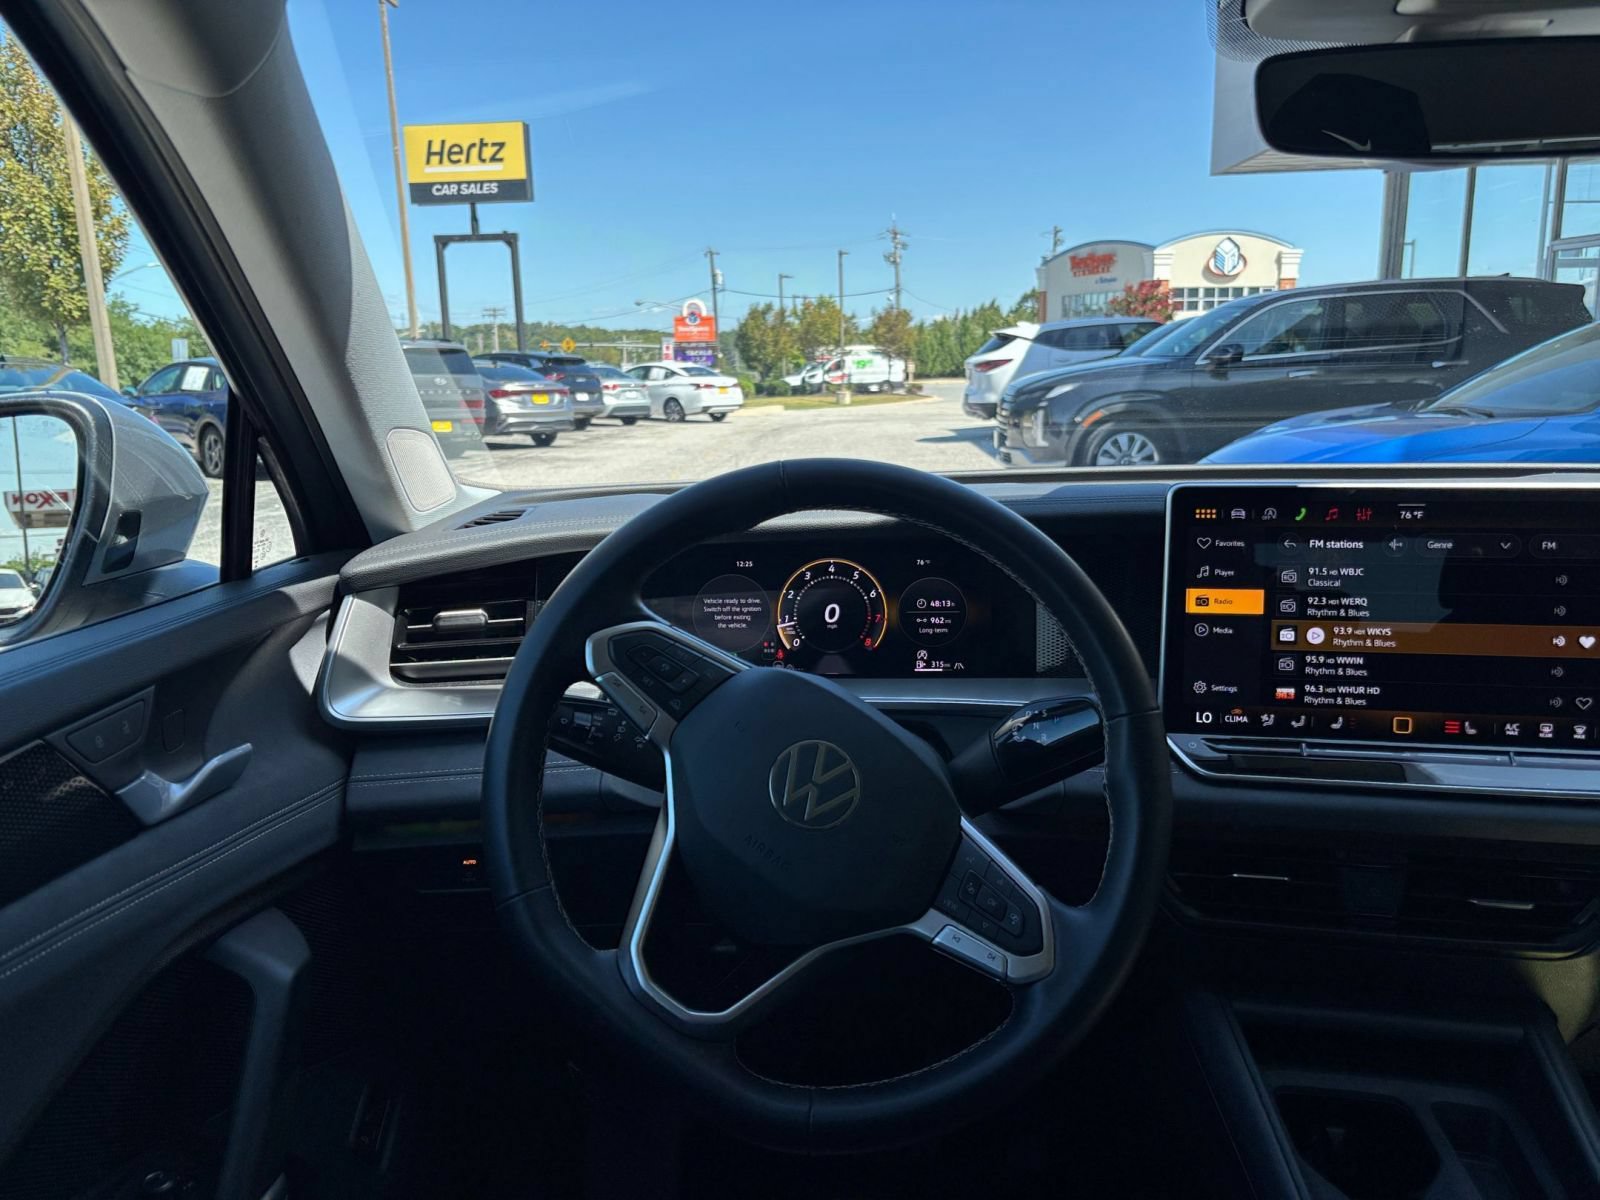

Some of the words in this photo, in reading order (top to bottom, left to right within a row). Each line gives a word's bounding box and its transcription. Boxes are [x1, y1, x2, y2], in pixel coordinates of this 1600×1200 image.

[425, 138, 506, 166] Hertz
[431, 184, 459, 196] CAR
[459, 182, 499, 195] SALES
[1399, 511, 1412, 519] 76
[1215, 540, 1245, 548] Favorites
[1309, 540, 1324, 549] FM
[1326, 540, 1364, 549] stations
[1427, 541, 1453, 550] Genre
[1542, 541, 1557, 550] FM
[828, 564, 836, 573] 4
[1214, 568, 1235, 577] Player
[1308, 567, 1328, 576] 91.5
[1339, 568, 1364, 576] WBJC
[804, 572, 812, 580] 3
[852, 572, 860, 580] 5
[1308, 579, 1341, 588] Classical
[787, 590, 795, 599] 2
[869, 590, 877, 598] 6
[1213, 598, 1233, 606] Radio
[1307, 597, 1327, 606] 92.3
[1340, 598, 1368, 607] WERQ
[824, 603, 841, 624] 0
[1307, 608, 1338, 618] Rhythm
[1339, 609, 1346, 617] &
[1348, 609, 1370, 618] Blues
[1213, 626, 1233, 634] Media
[1333, 627, 1353, 635] 93.9
[1366, 628, 1392, 636] WKYS
[793, 638, 800, 647] 0
[864, 638, 872, 647] 8
[1332, 638, 1364, 648] Rhythm
[1374, 639, 1396, 648] Blues
[1305, 656, 1325, 664] 95.9
[1336, 656, 1364, 665] WWIN
[1305, 667, 1336, 676] Rhythm
[1345, 668, 1368, 676] Blues
[1211, 684, 1238, 694] Settings
[1304, 685, 1323, 693] 96.3
[1337, 686, 1365, 694] WHUR
[1366, 687, 1380, 695] HD
[1304, 696, 1335, 706] Rhythm
[1344, 697, 1367, 706] Blues
[1195, 712, 1212, 723] LO
[1224, 715, 1248, 723] CLIMA
[1504, 723, 1520, 731] A/C
